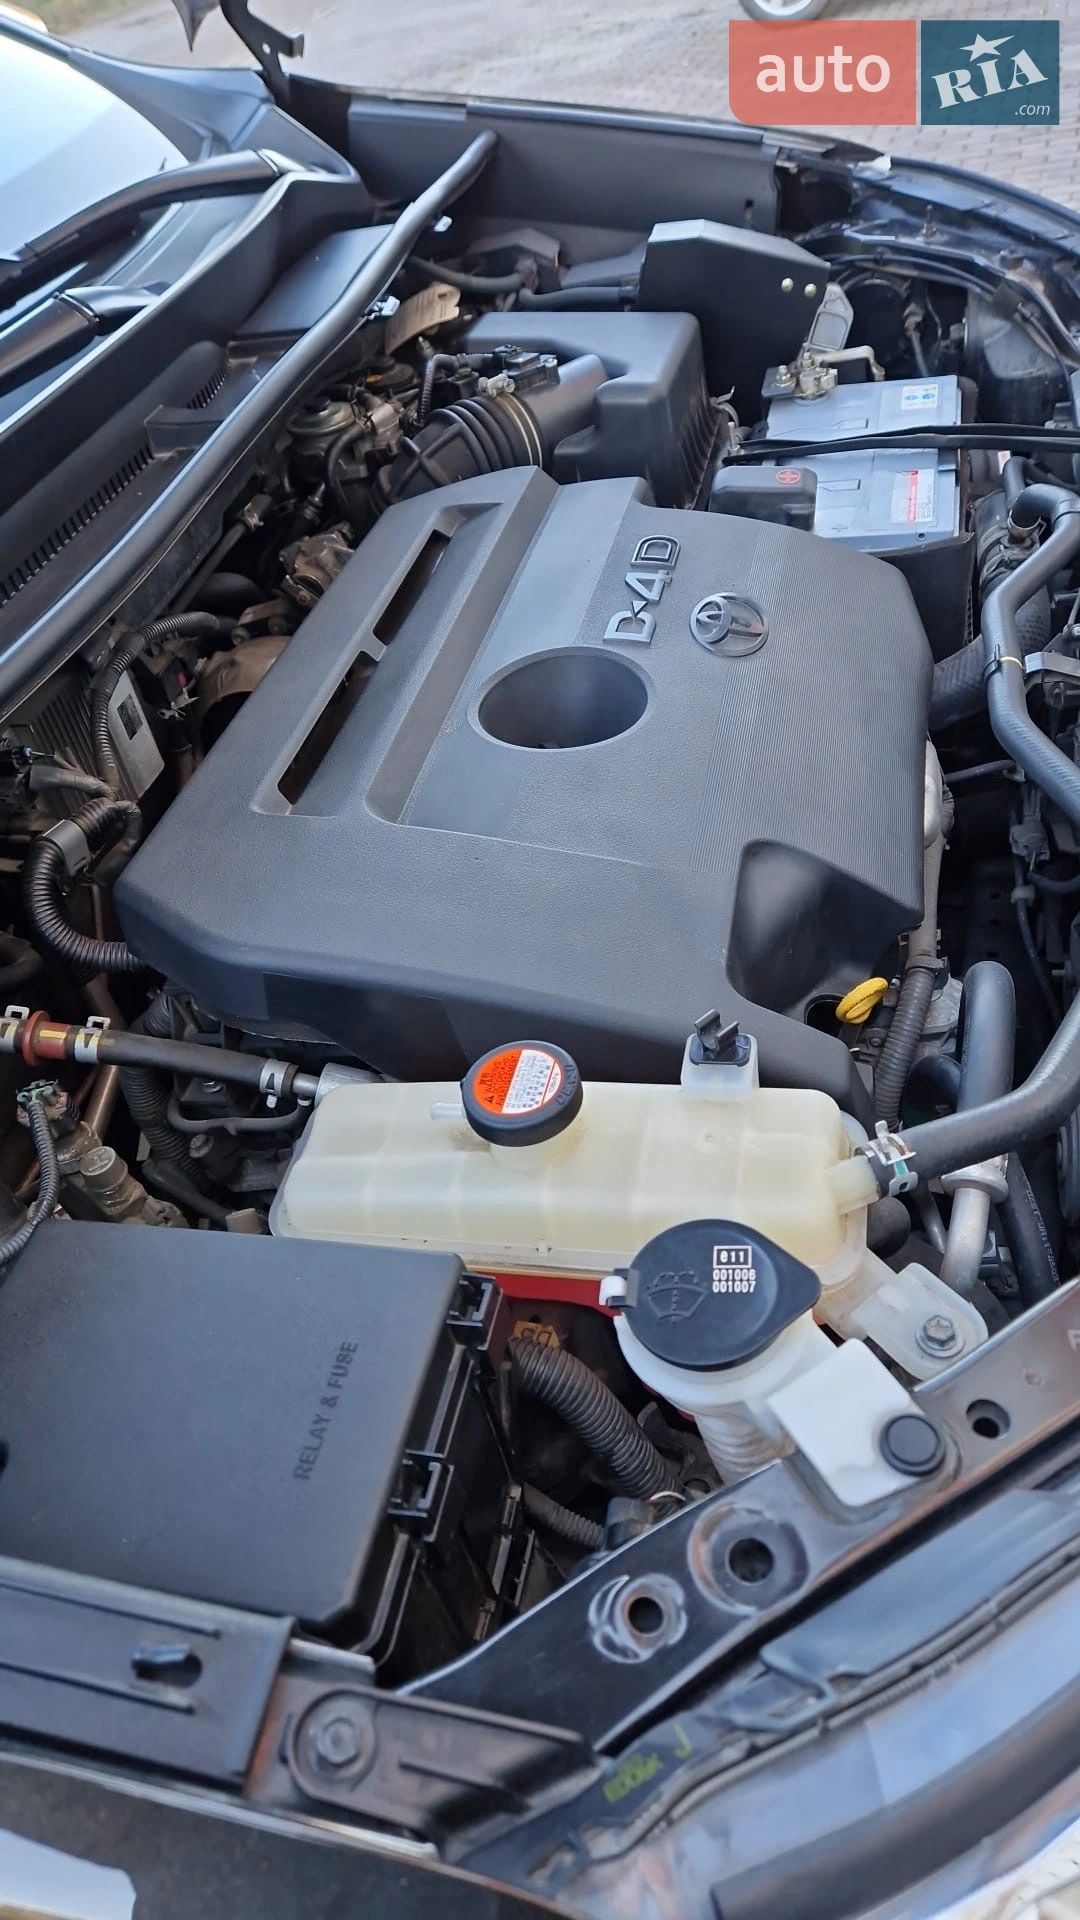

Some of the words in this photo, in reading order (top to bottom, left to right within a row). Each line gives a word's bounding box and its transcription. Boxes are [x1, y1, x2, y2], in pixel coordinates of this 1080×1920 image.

[720, 1250, 745, 1263] e11
[712, 1268, 757, 1281] 001006
[712, 1281, 756, 1294] 001007
[327, 1341, 358, 1389] FUSE
[320, 1395, 339, 1408] &
[293, 1413, 332, 1480] RELAY
